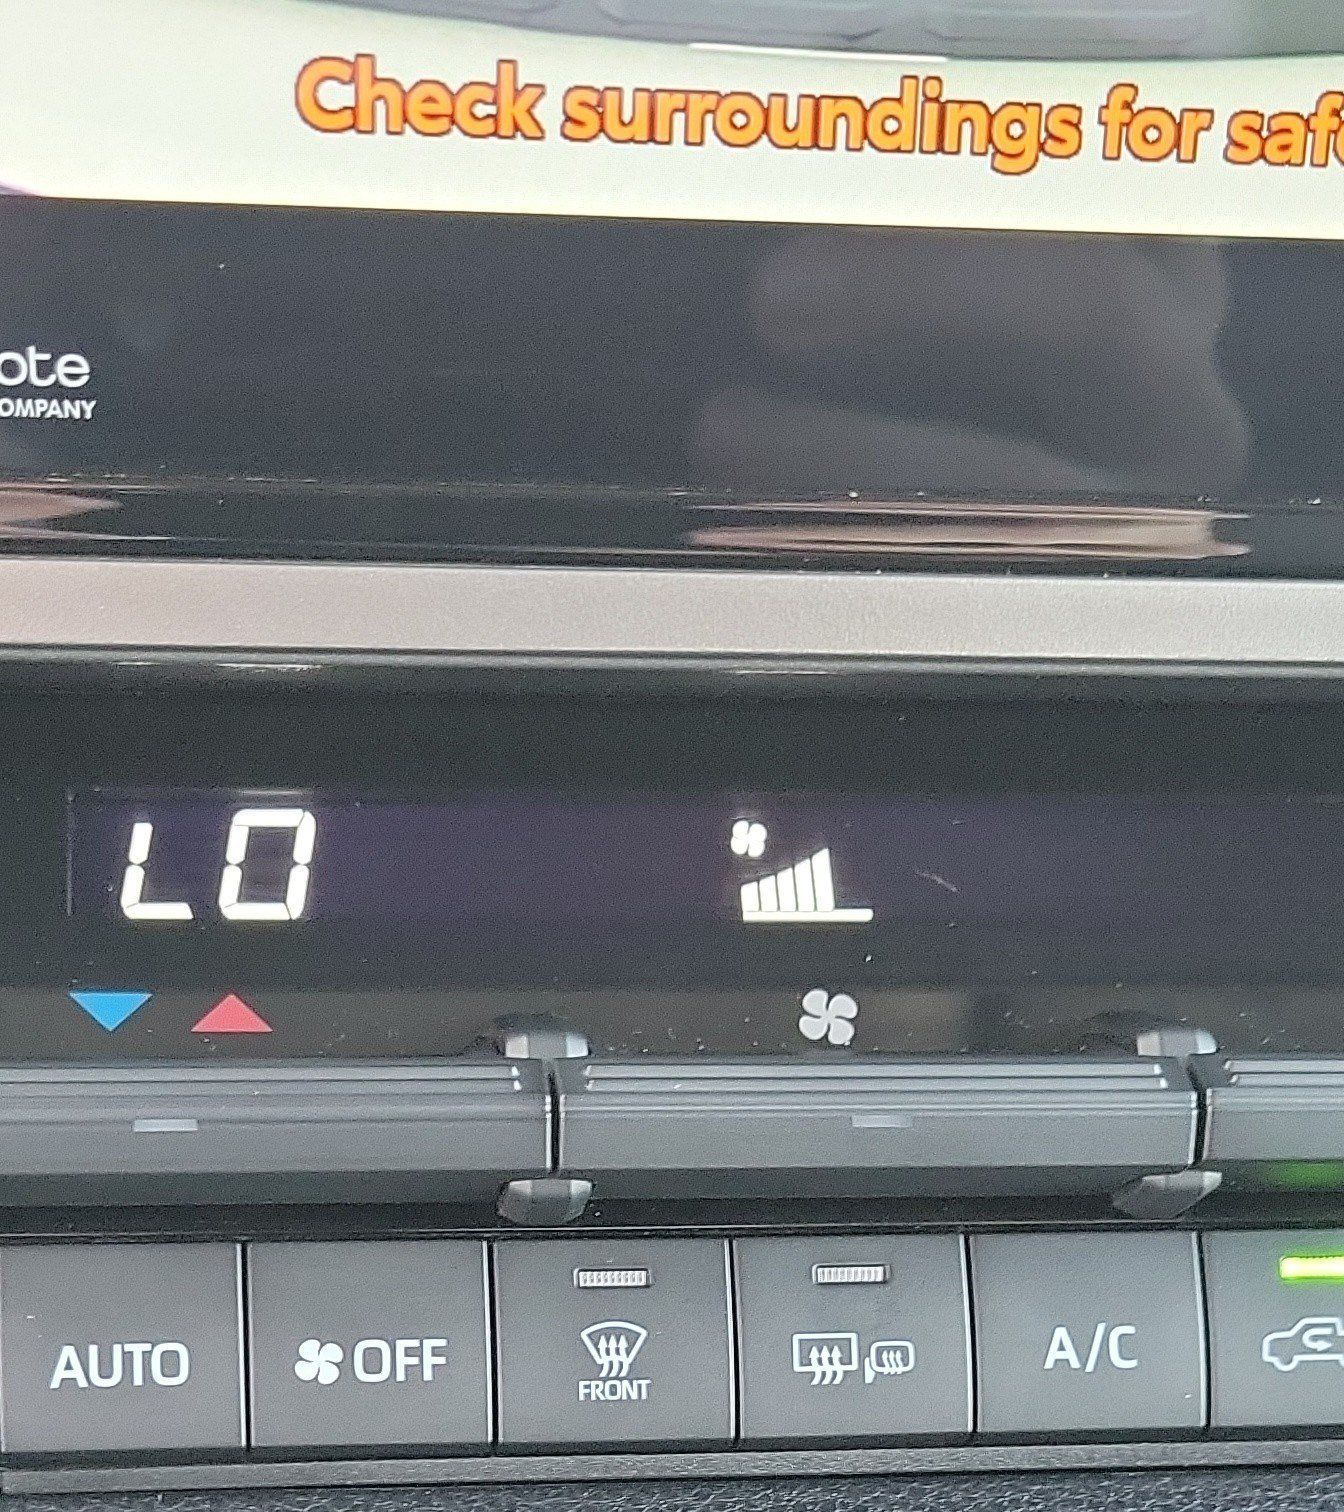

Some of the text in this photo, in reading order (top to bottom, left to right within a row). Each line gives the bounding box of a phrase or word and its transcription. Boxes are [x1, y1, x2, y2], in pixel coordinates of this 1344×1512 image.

[294, 55, 547, 142] Check
[559, 75, 1083, 176] surroundings
[1099, 85, 1215, 163] for
[50, 1341, 190, 1389] AUTO
[354, 1338, 449, 1383] OFF
[1043, 1322, 1139, 1373] A/C
[577, 1379, 652, 1401] FRONT
